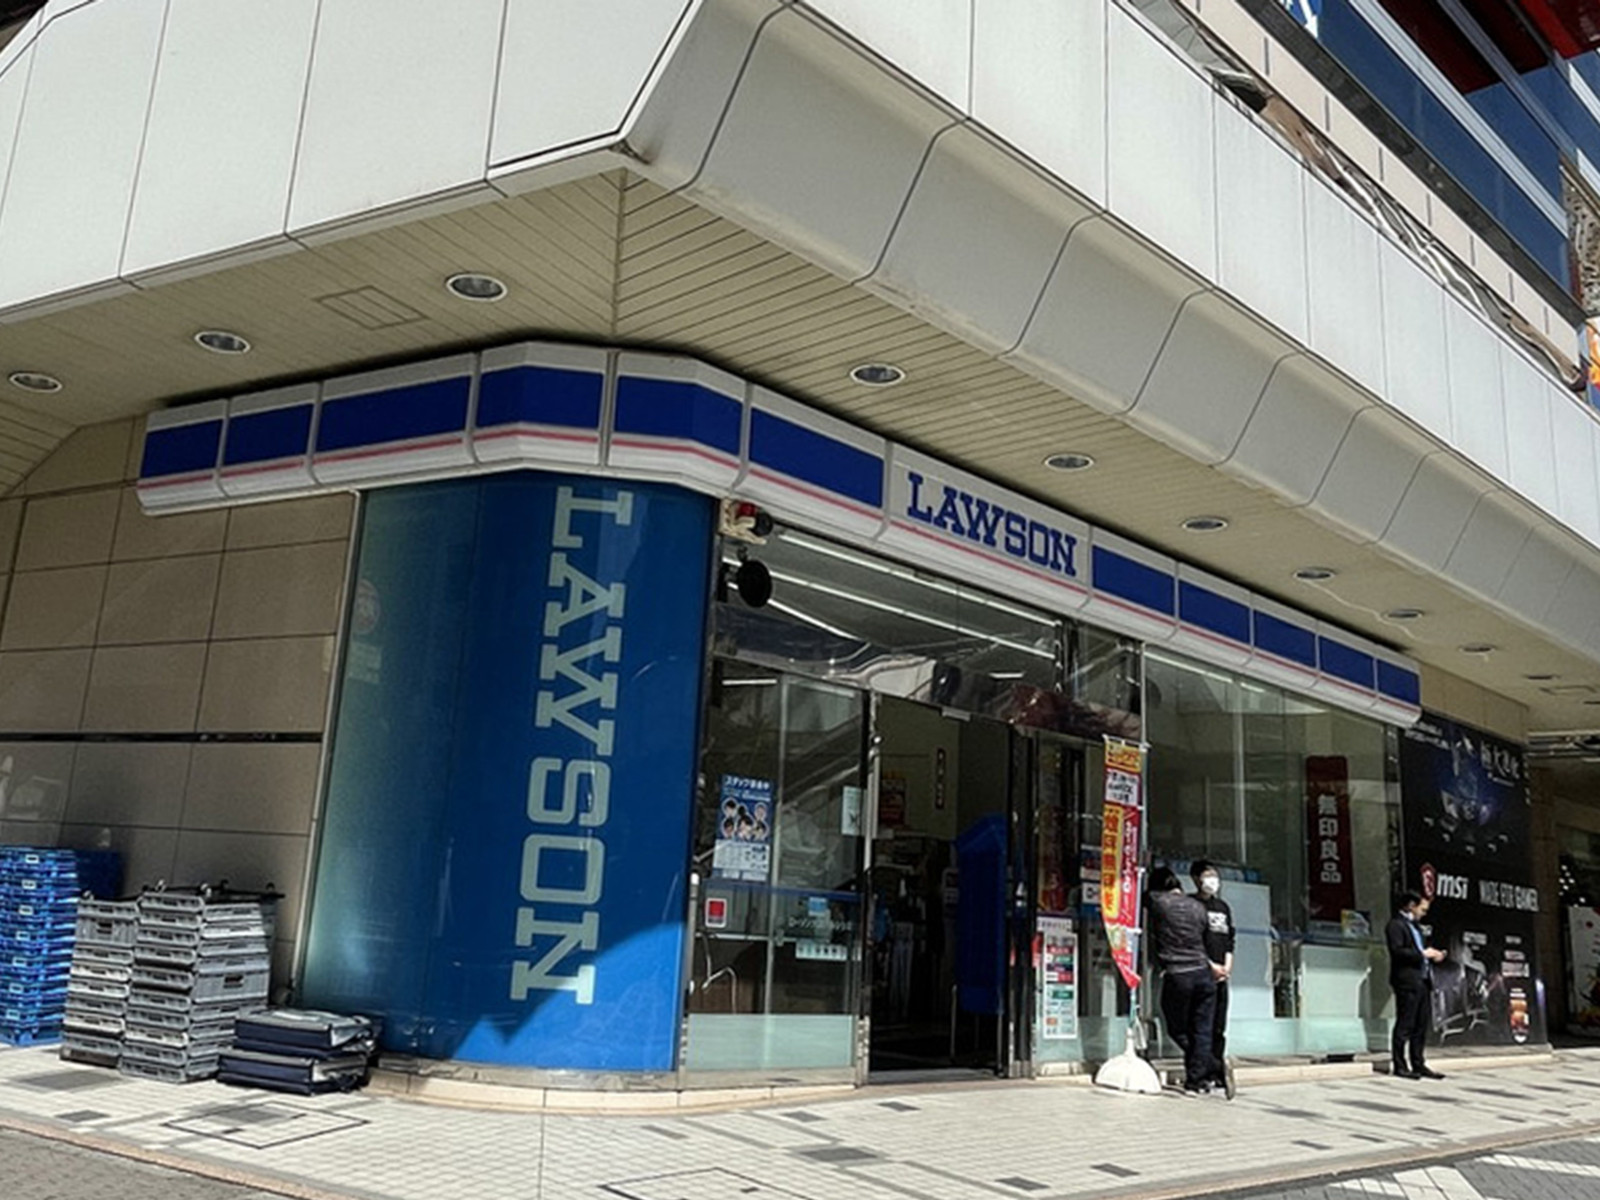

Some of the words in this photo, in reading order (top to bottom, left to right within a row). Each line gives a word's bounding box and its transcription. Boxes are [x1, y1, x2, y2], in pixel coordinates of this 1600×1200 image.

[907, 471, 1078, 578] LAWSON
[509, 485, 634, 1005] LAWSON
[1317, 793, 1342, 884] 無印良品
[1436, 872, 1469, 901] msi
